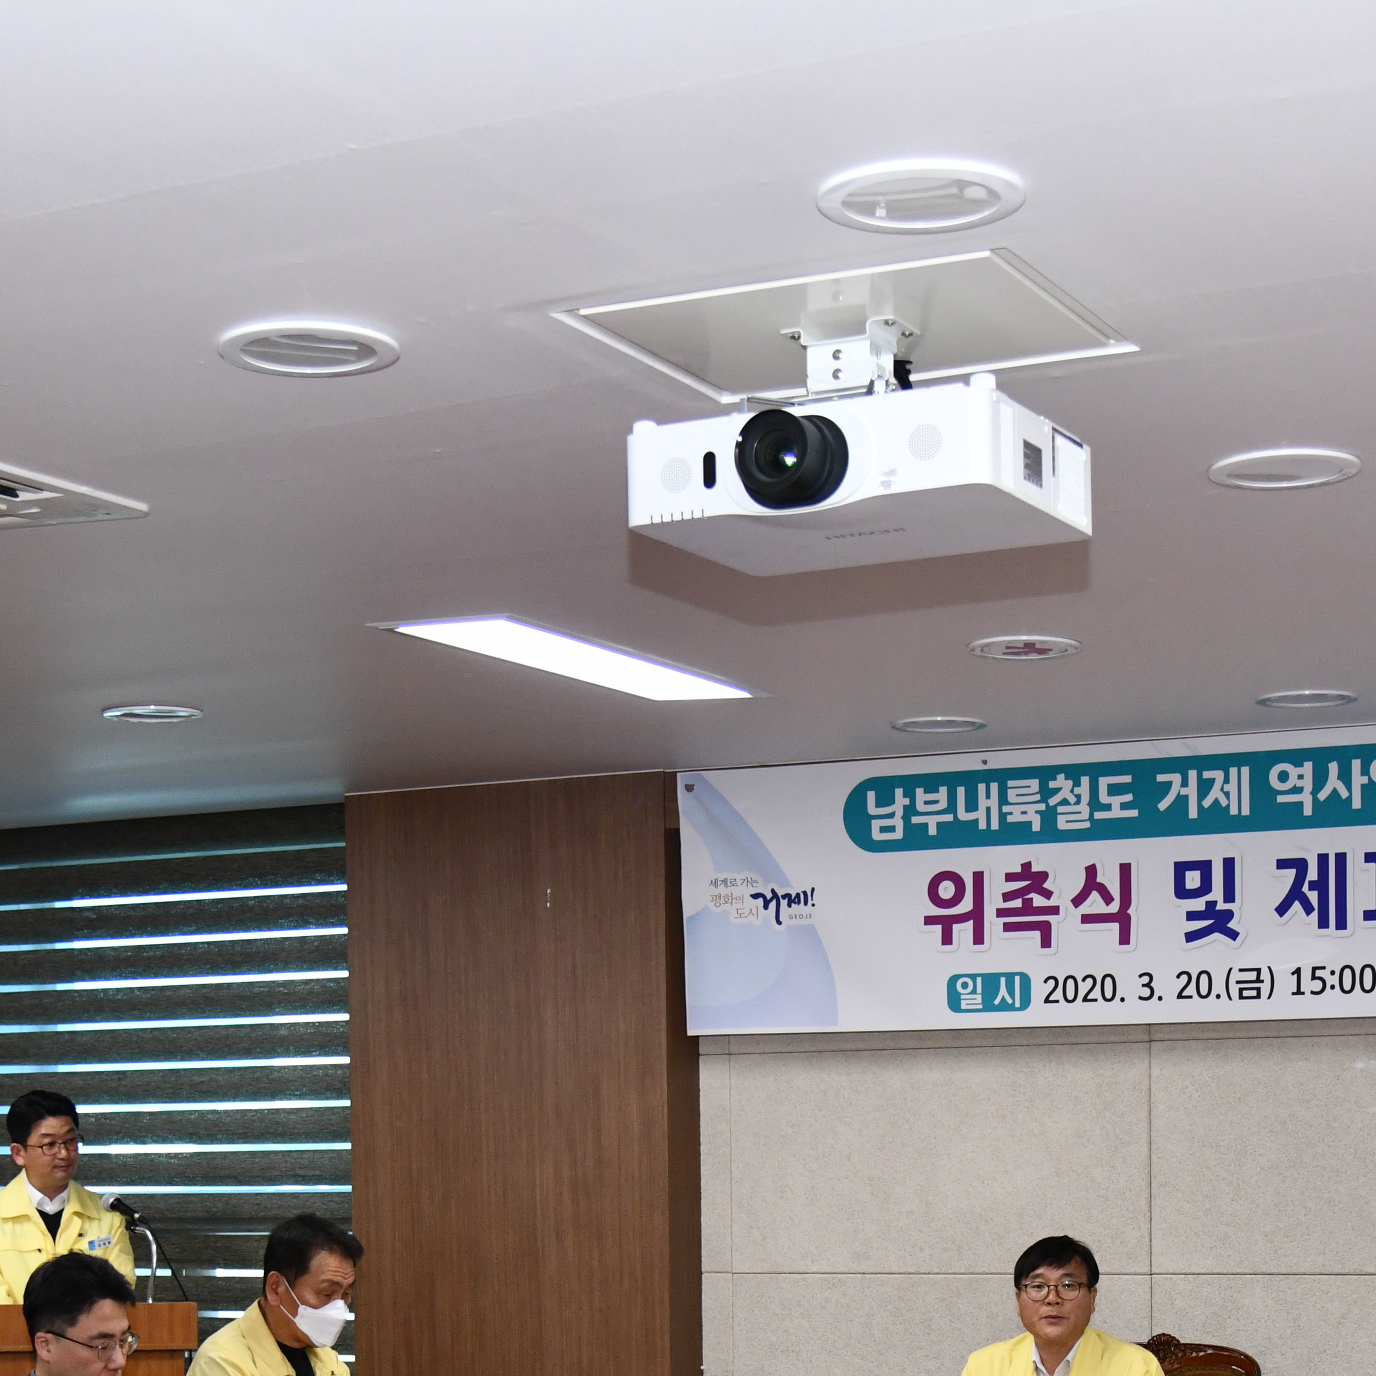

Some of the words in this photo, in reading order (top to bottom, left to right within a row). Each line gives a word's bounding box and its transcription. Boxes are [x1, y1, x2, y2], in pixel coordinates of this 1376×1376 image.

[866, 773, 1138, 841] 남부내륙철도
[1157, 766, 1250, 819] 거제
[709, 878, 739, 889] 세계로
[740, 877, 759, 888] 가는
[710, 893, 744, 907] 평화의
[734, 906, 759, 920] 도시
[924, 861, 1132, 949] 위촉식
[1174, 856, 1241, 944] 및
[1043, 973, 1125, 1004] 2020.
[1138, 972, 1163, 1001] 3.
[1175, 966, 1275, 1001] 20.(금)
[1290, 963, 1376, 995] 15:00
